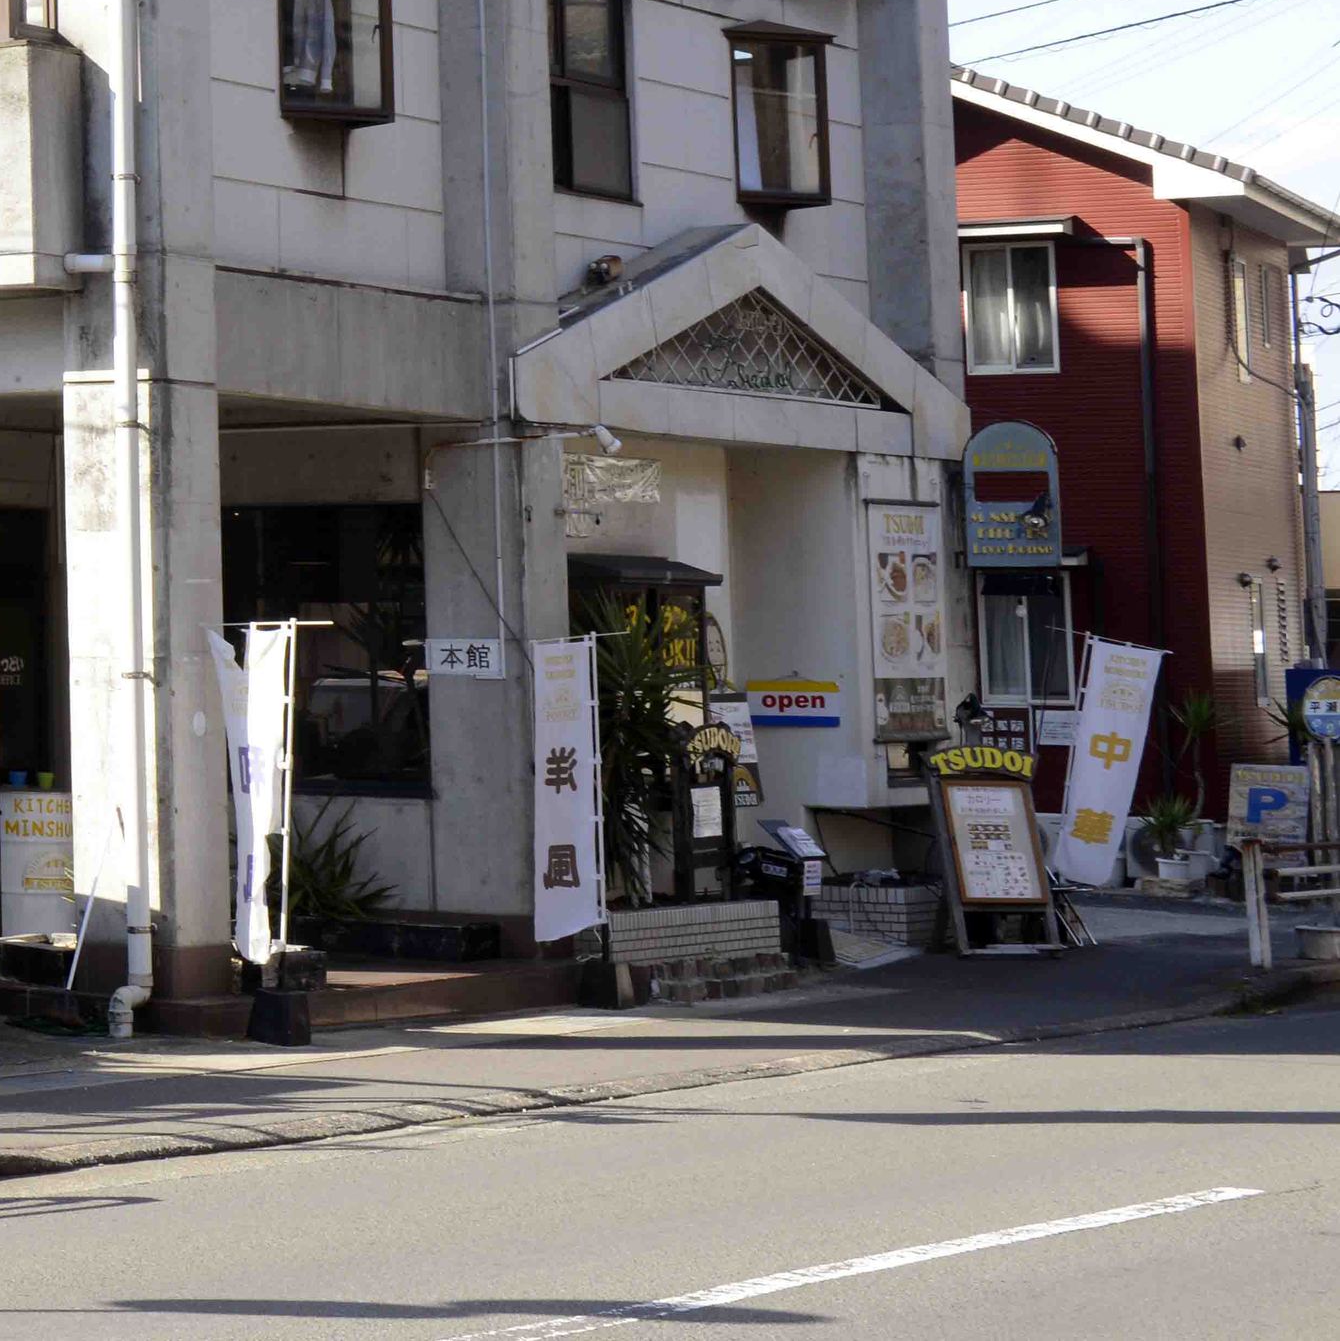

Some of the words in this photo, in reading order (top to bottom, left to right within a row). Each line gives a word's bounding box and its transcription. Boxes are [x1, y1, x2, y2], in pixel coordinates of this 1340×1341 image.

[440, 644, 491, 670] 本館
[762, 694, 826, 712] open
[930, 746, 1033, 777] TSUDOI
[1246, 787, 1288, 824] P
[4, 819, 72, 837] MINSHU
